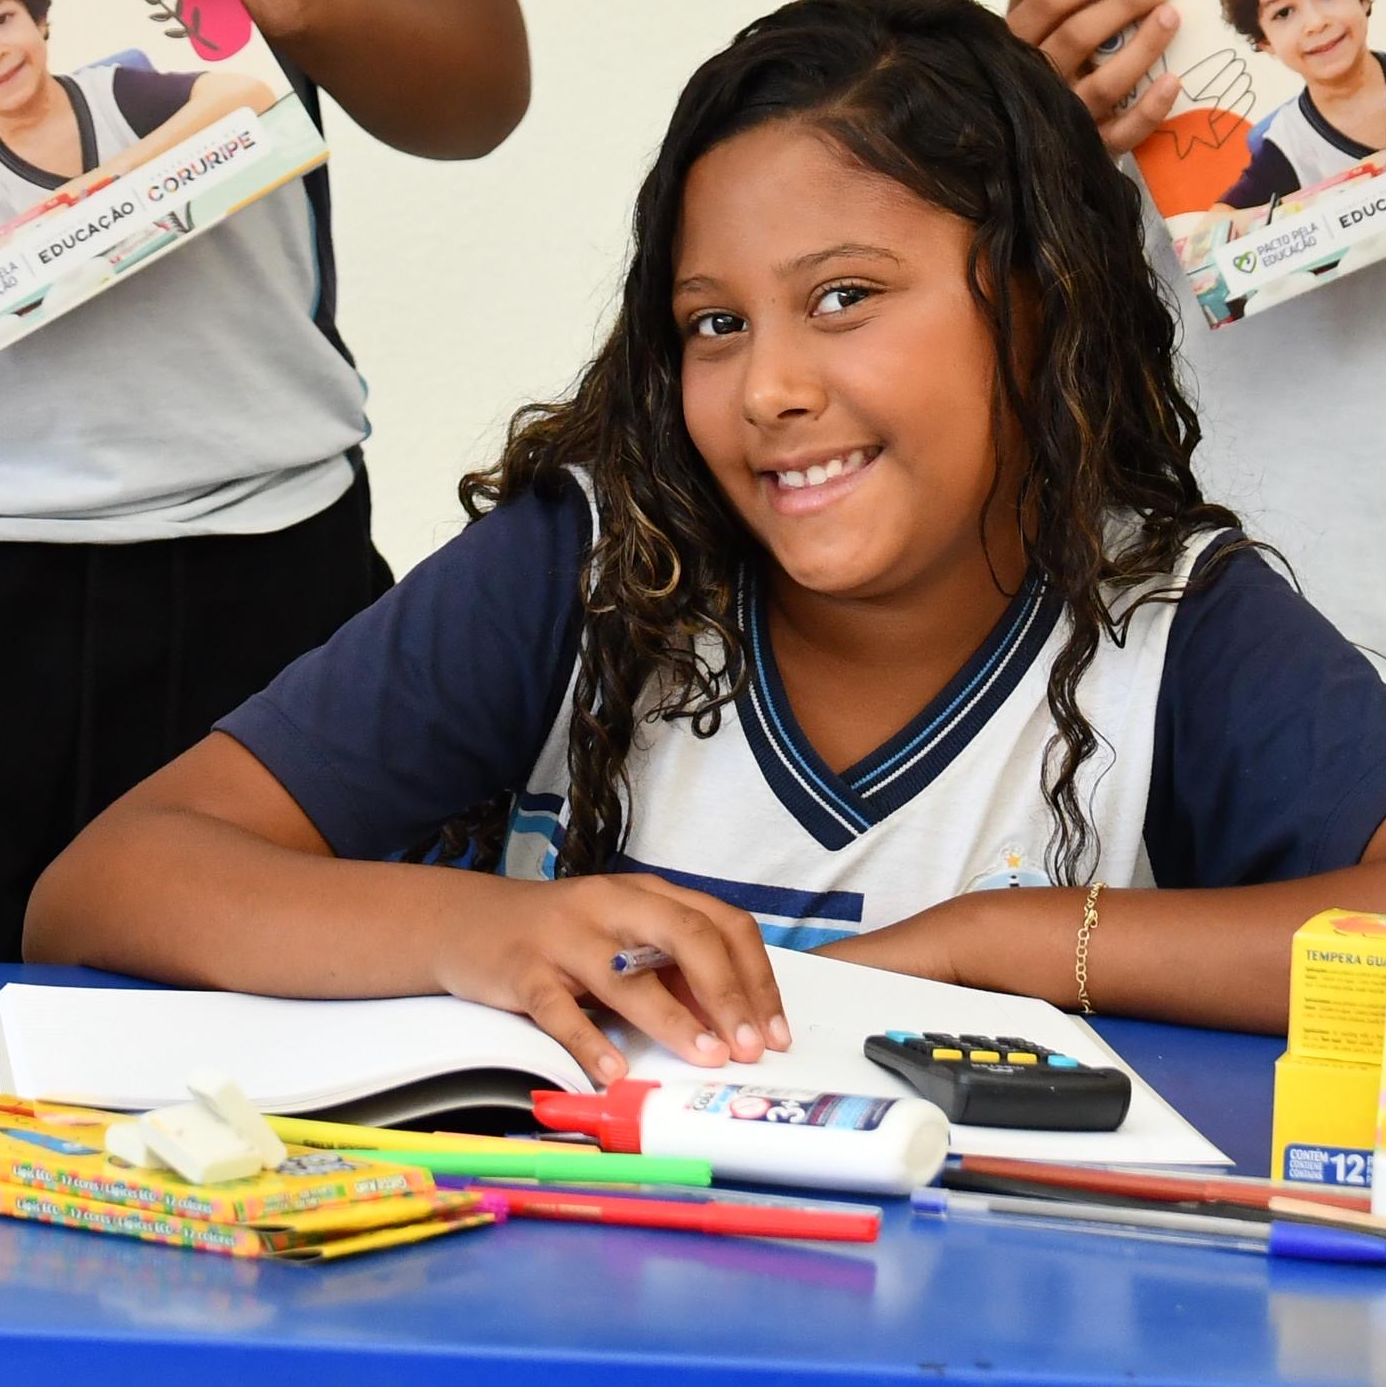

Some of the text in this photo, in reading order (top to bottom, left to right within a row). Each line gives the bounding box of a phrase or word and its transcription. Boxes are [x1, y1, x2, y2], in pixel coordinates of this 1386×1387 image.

[148, 130, 256, 204] CORURIPE
[37, 200, 135, 265] EDUCAÇÃO
[1291, 222, 1319, 247] PELA
[1306, 949, 1362, 965] TEMPERA
[1329, 1152, 1366, 1184] 12
